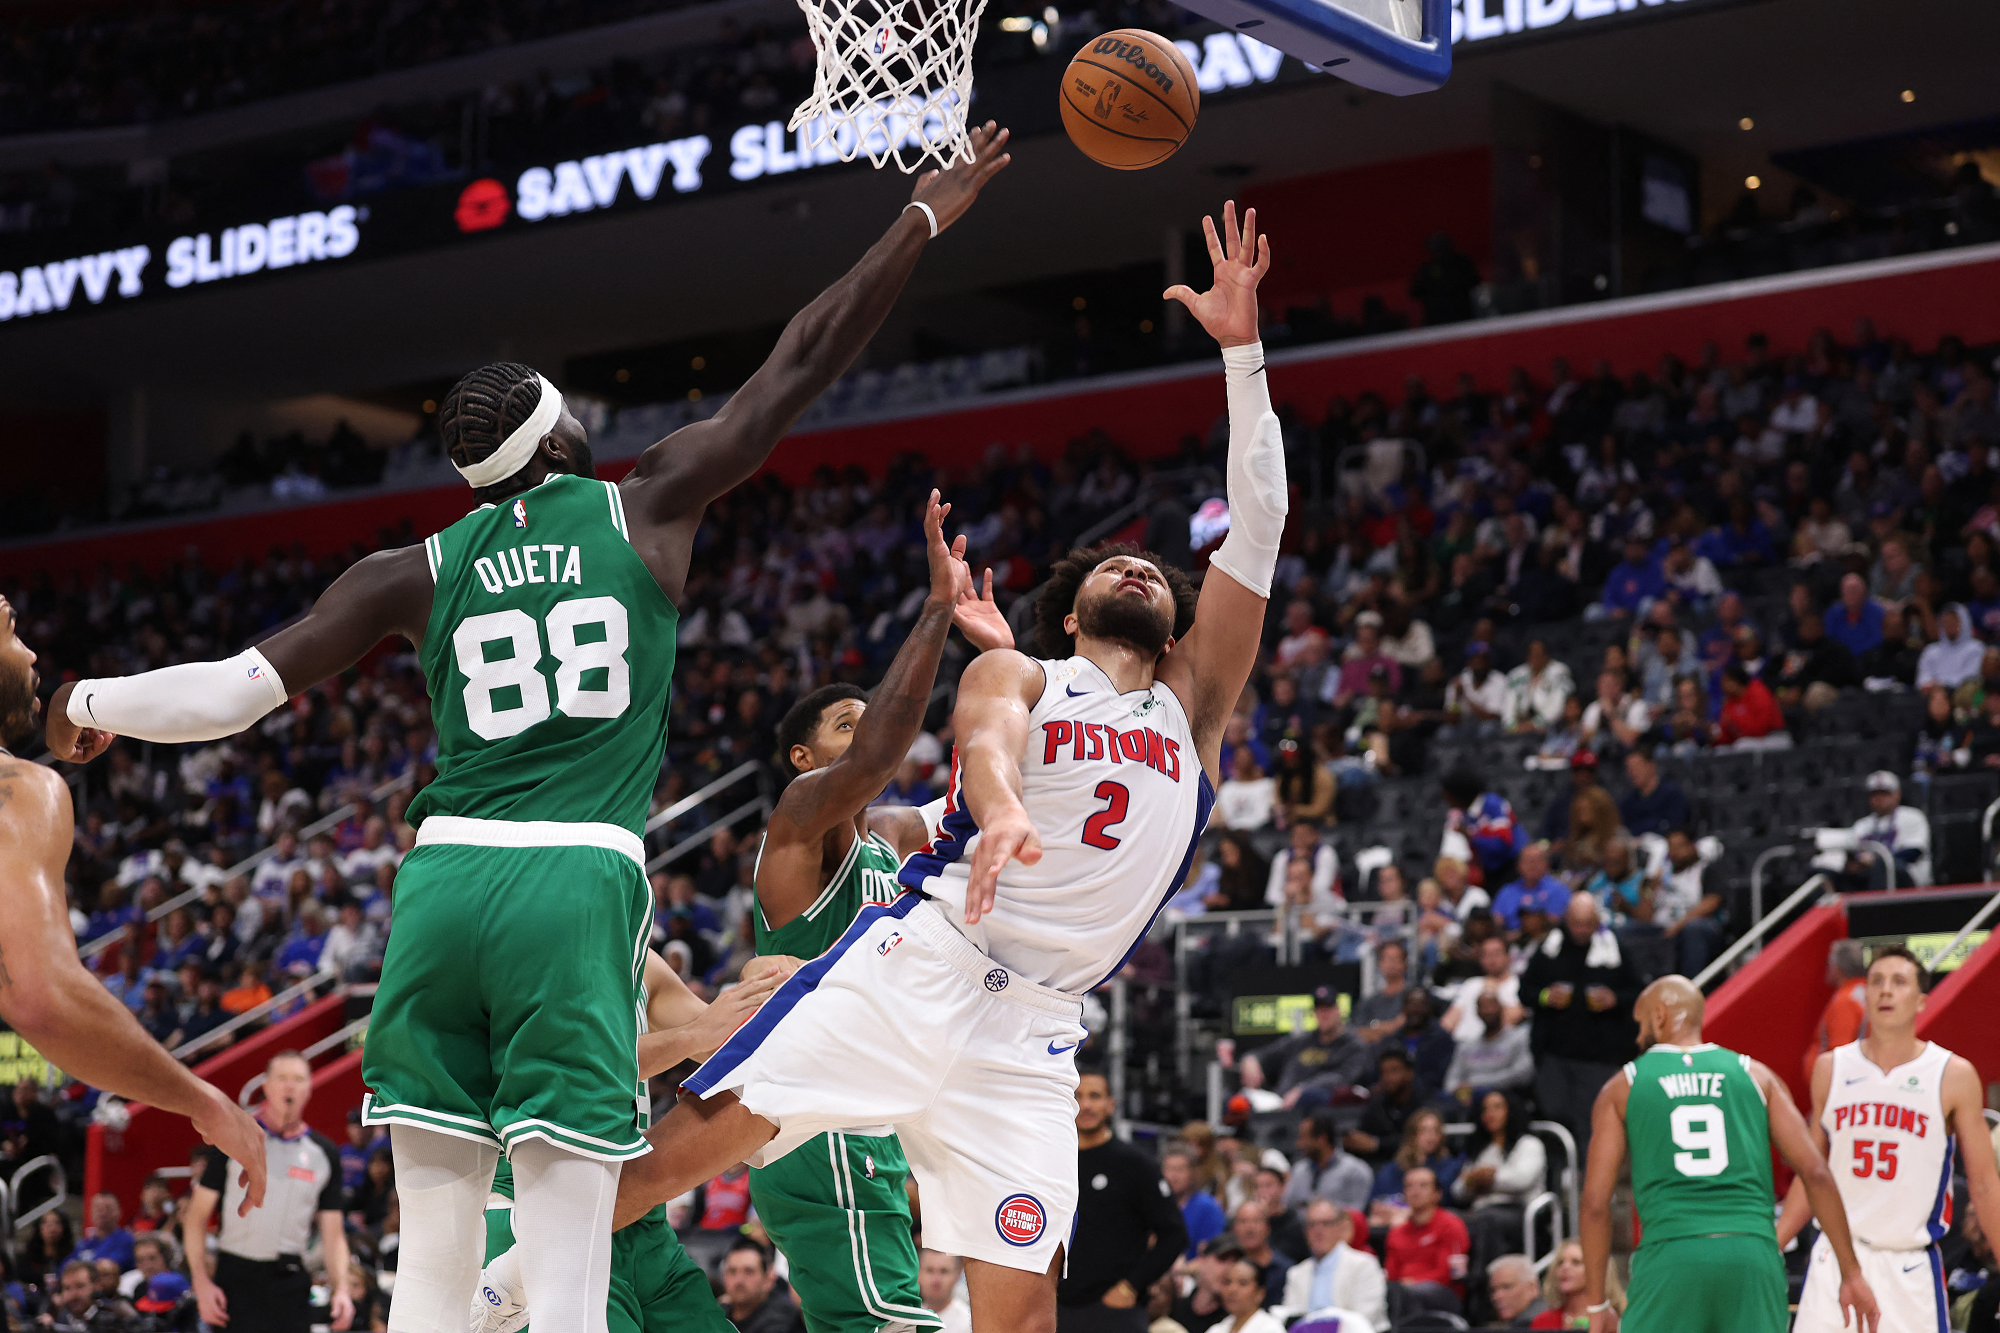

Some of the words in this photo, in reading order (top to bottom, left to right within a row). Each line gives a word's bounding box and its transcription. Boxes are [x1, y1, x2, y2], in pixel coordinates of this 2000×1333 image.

[1092, 37, 1174, 95] Wilson
[516, 134, 712, 222] SAVVY
[729, 87, 962, 182] SLIDERS
[0, 245, 150, 321] SAVVY
[165, 205, 360, 288] SLIDERS
[473, 544, 582, 594] QUETA
[452, 595, 631, 741] 88
[1041, 720, 1180, 783] PISTONS
[1081, 780, 1130, 851] 2
[1658, 1072, 1726, 1099] WHITE
[1670, 1103, 1729, 1177] 9
[1834, 1103, 1929, 1138] PISTONS
[1852, 1140, 1899, 1181] 55
[1005, 1216, 1037, 1232] PISTONS
[1007, 1208, 1038, 1223] DETROIT
